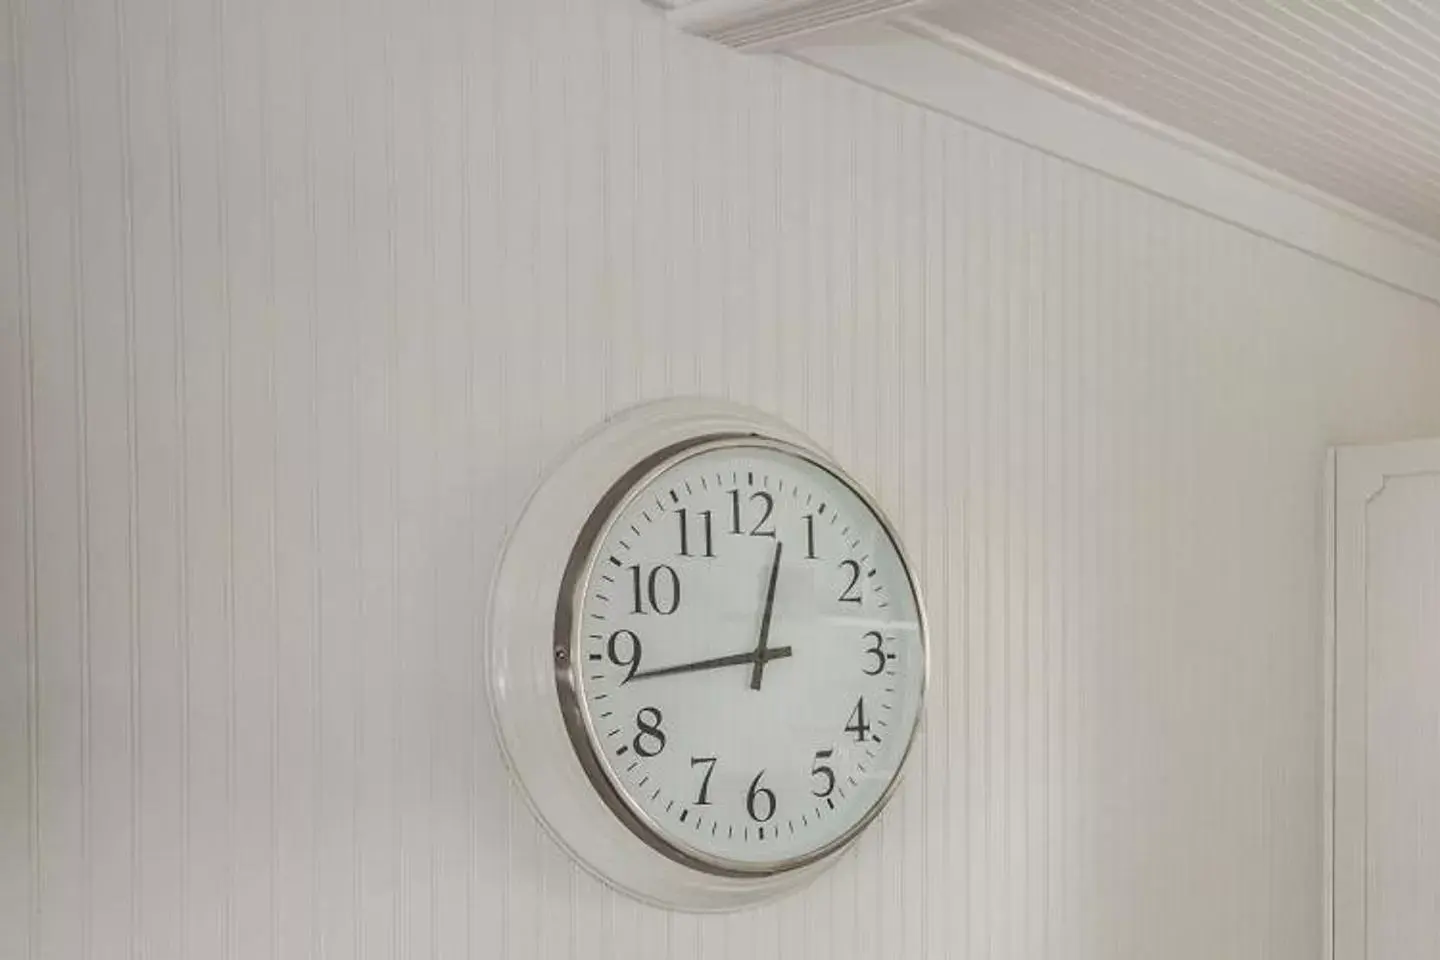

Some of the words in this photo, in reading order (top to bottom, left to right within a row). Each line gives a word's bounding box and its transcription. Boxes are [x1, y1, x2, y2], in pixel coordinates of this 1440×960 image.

[675, 508, 716, 558] 11
[727, 489, 776, 538] 12
[801, 514, 820, 560] 1
[625, 564, 682, 616] 10
[838, 559, 863, 603] 2
[607, 629, 642, 686] 9
[862, 631, 886, 675] 3
[632, 706, 666, 757] 8
[845, 695, 871, 743] 4
[690, 757, 717, 806] 7
[746, 769, 777, 822] 6
[811, 750, 836, 798] 5
